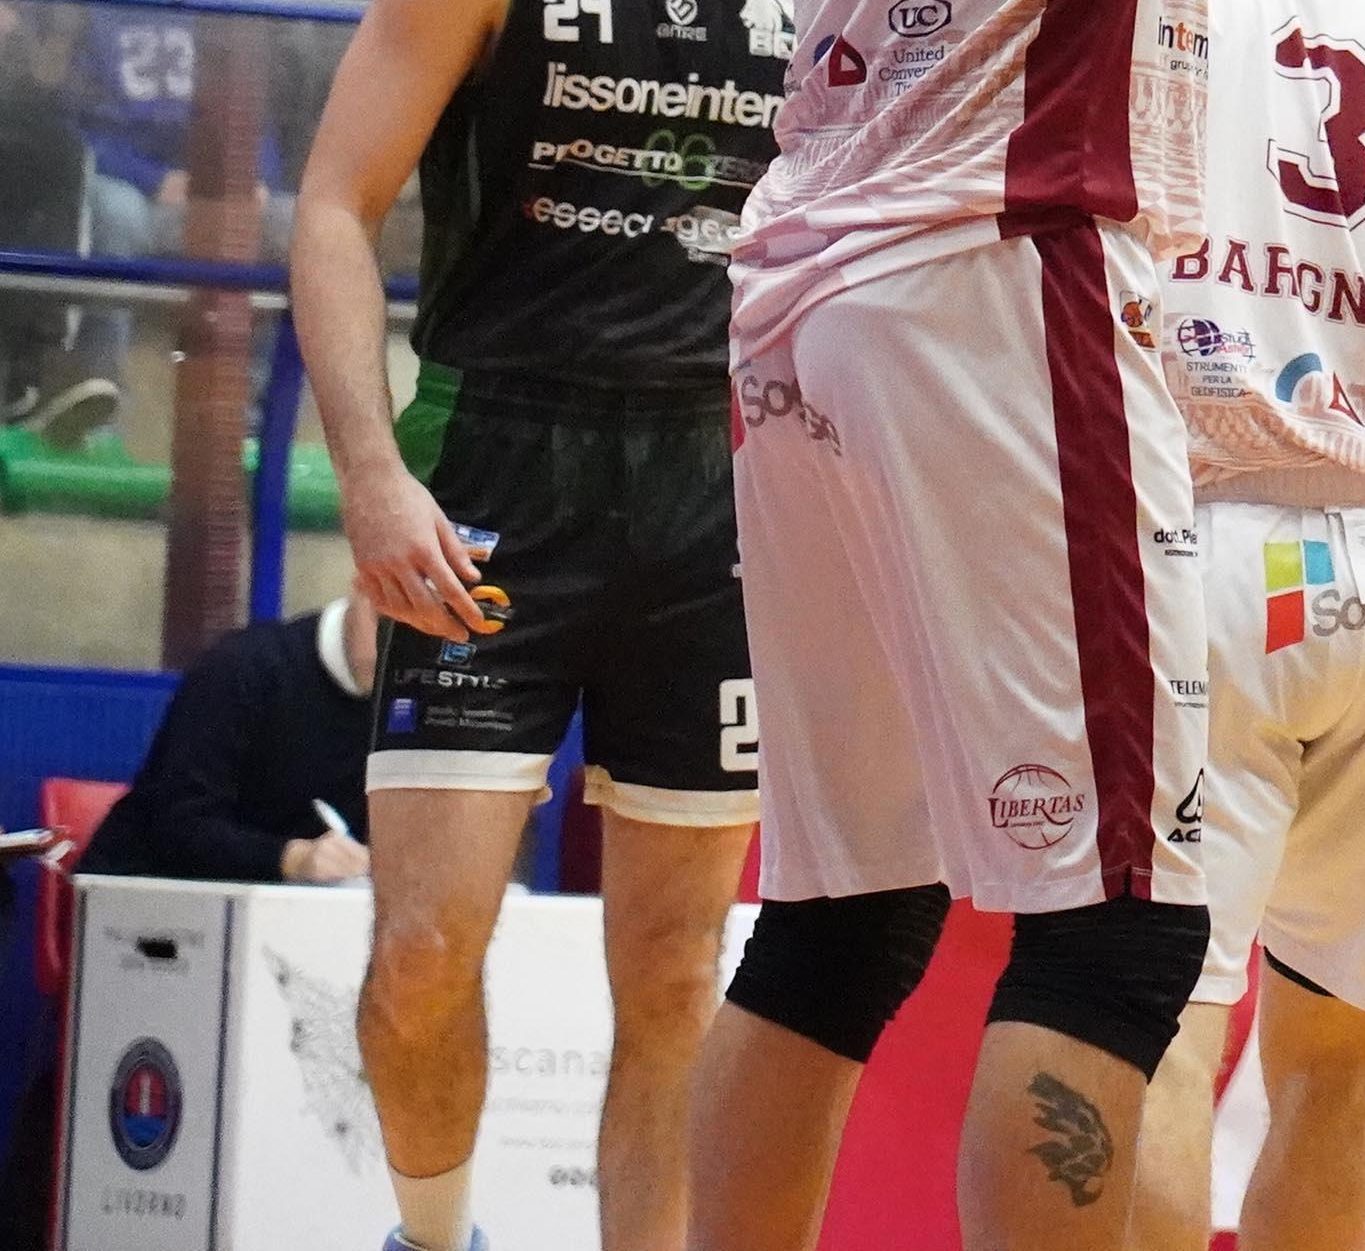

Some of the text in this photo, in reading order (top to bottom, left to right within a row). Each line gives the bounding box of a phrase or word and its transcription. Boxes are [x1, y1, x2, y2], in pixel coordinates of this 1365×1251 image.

[900, 5, 939, 29] UC
[894, 45, 945, 63] United
[988, 794, 1085, 828] LIBERTAS
